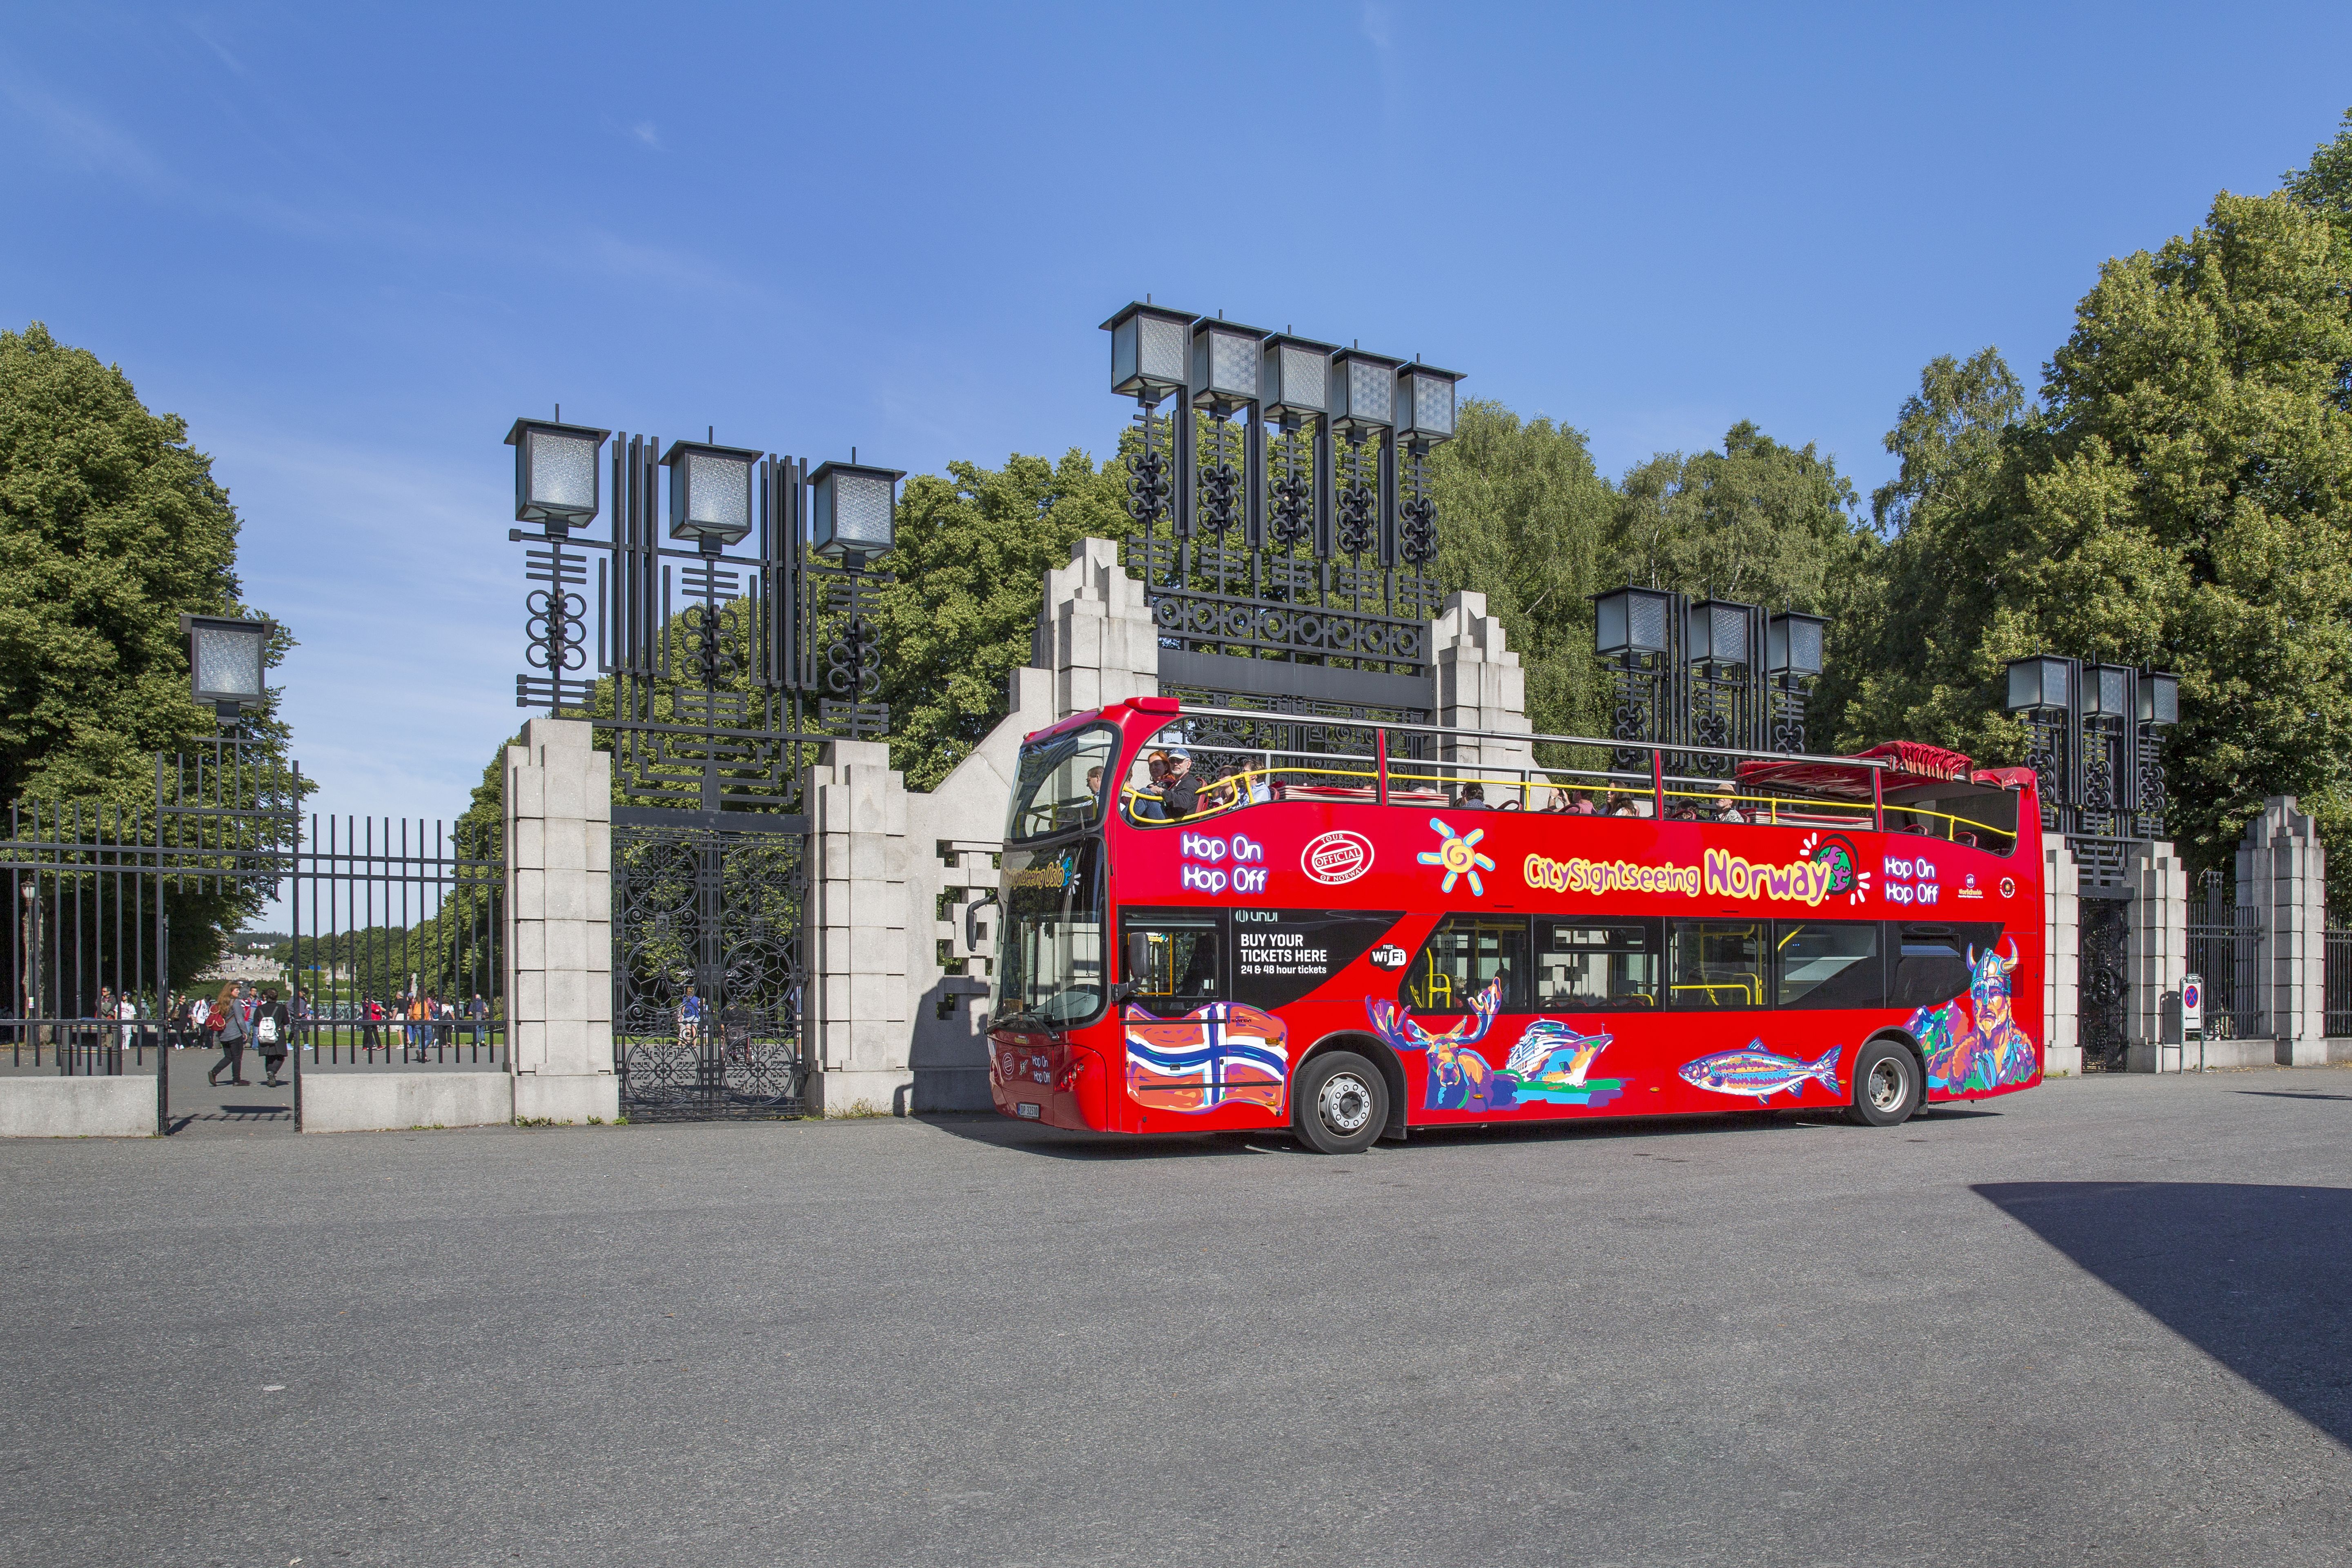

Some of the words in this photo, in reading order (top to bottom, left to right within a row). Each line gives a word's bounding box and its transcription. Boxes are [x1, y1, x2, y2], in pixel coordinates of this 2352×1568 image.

[1321, 834, 1344, 844] TOUR
[1183, 834, 1226, 862] Hop
[1232, 835, 1261, 860] On
[1315, 849, 1361, 866] OFFICIAL
[1045, 862, 1065, 888] Oslo
[1334, 865, 1363, 882] NORWAY
[1884, 857, 1913, 879] Hop
[1915, 858, 1935, 878] On
[1183, 866, 1227, 893] Hop
[1233, 866, 1269, 891] Off
[1705, 849, 1829, 905] Norway
[1885, 882, 1914, 904] Hop
[1917, 883, 1940, 903] Off
[1241, 934, 1267, 947] BUY
[1269, 934, 1303, 947] YOUR
[1241, 949, 1292, 962] TICKETS
[1295, 949, 1327, 962] HERE
[1241, 965, 1252, 974] 24
[1254, 965, 1262, 974] &
[1263, 965, 1274, 974] 48
[1276, 965, 1296, 974] hour
[1298, 965, 1327, 974] tickets
[1032, 1055, 1041, 1068] Hop
[1042, 1056, 1048, 1067] On
[1033, 1071, 1043, 1083] Hop
[1021, 1105, 1026, 1114] DP
[1027, 1106, 1038, 1116] 32510
